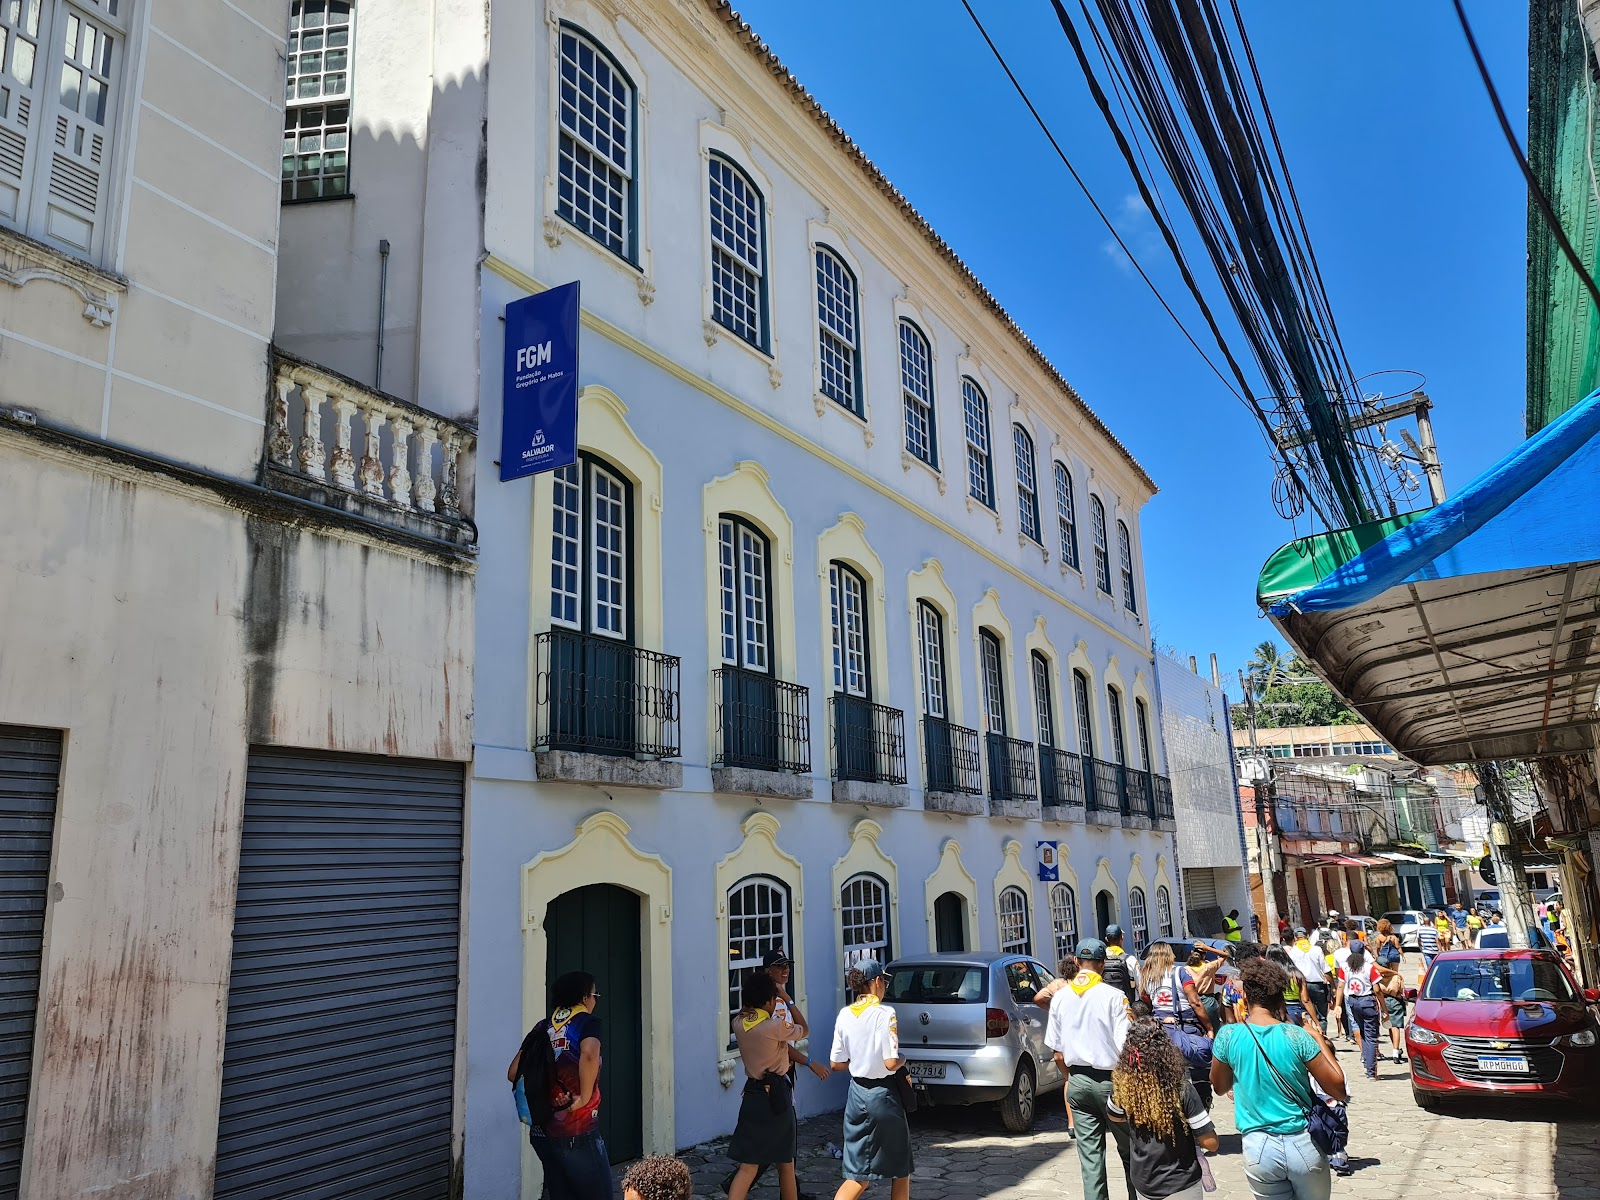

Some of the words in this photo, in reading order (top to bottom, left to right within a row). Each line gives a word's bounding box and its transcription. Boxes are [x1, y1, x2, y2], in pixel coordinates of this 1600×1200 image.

[517, 340, 551, 372] FGM
[516, 370, 541, 382] Fundação
[516, 378, 538, 389] Gregório
[548, 371, 563, 379] Matos
[522, 444, 554, 458] SALVADOR
